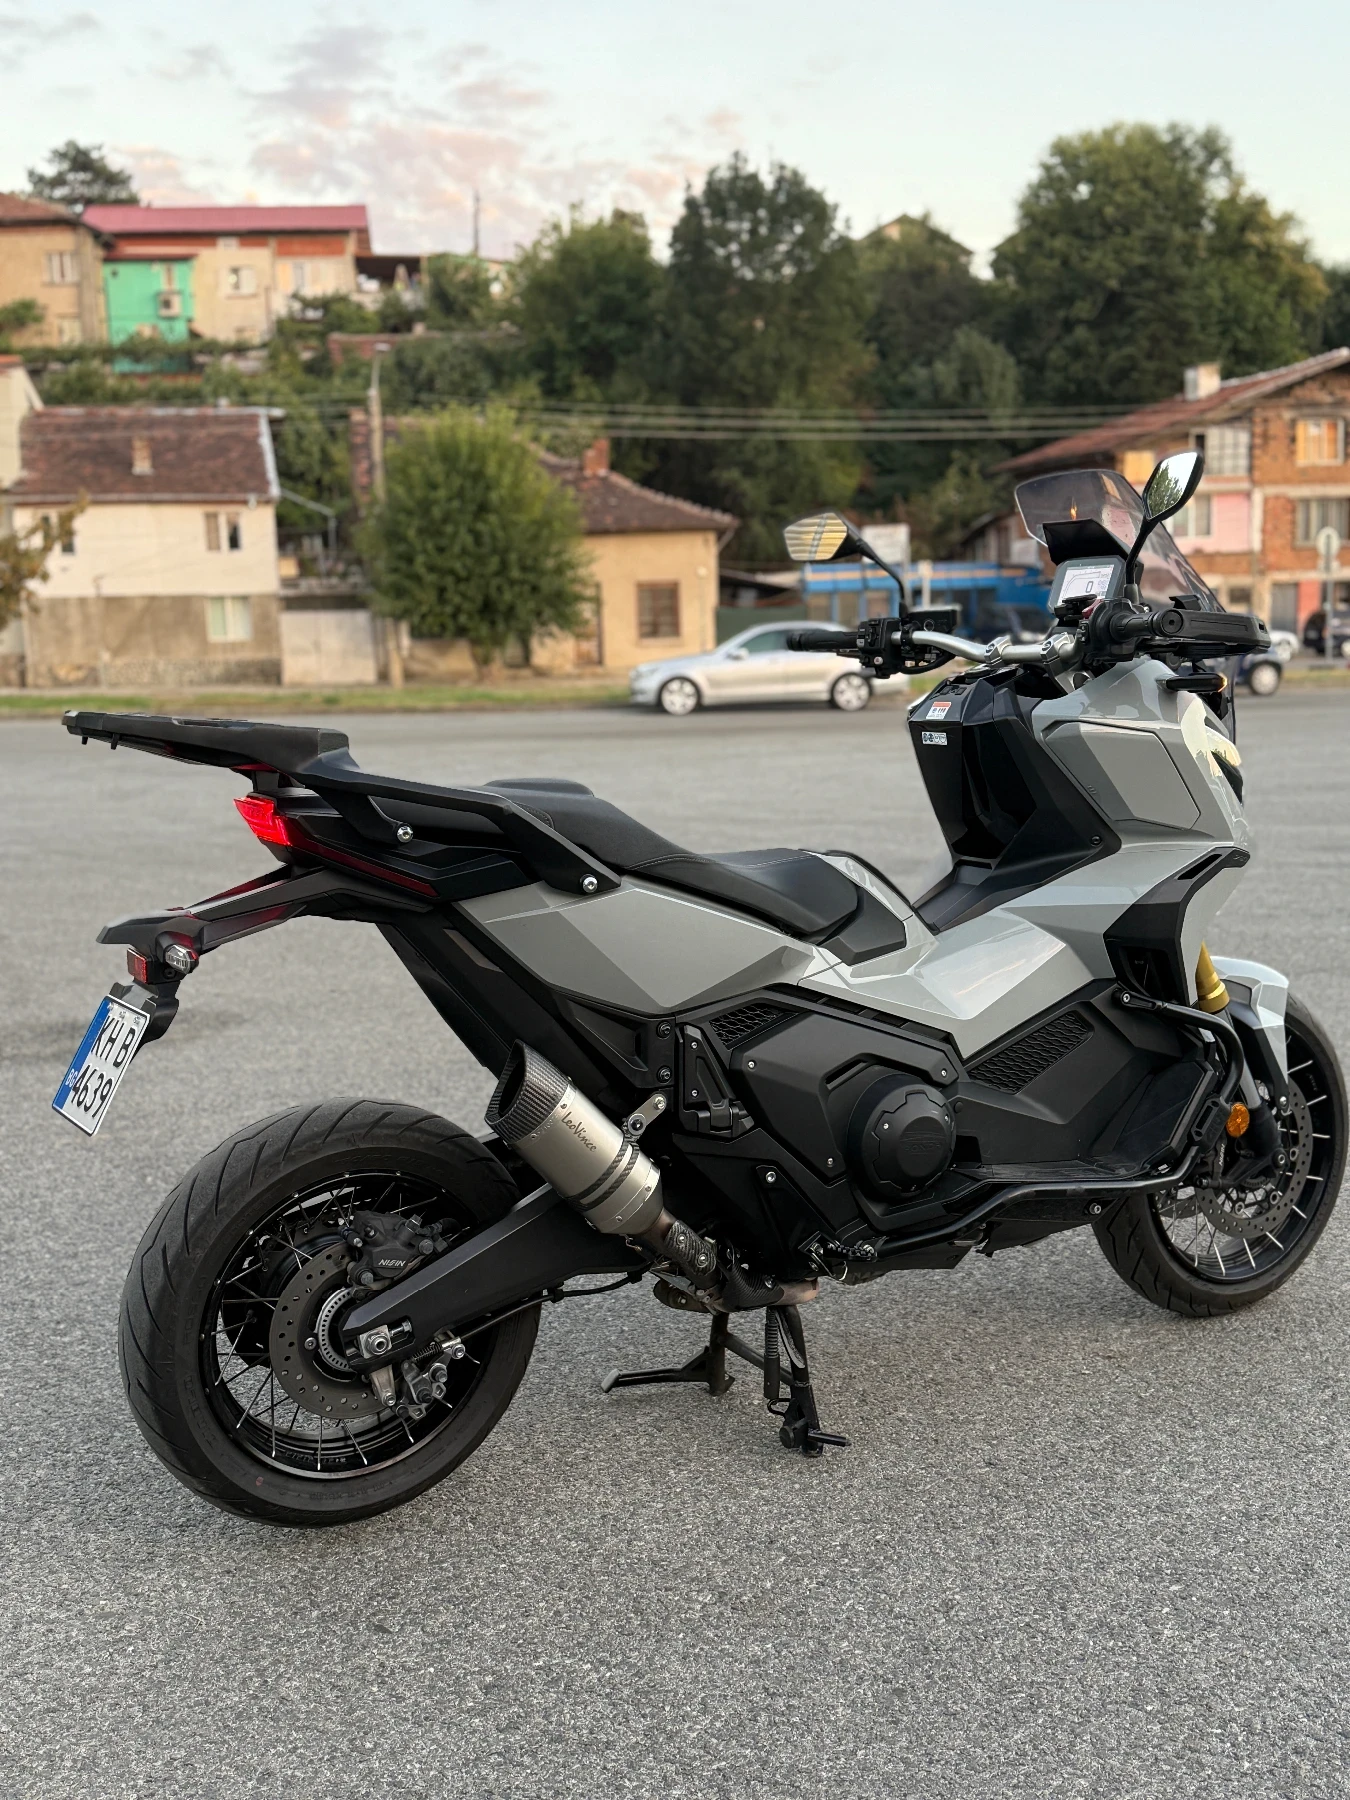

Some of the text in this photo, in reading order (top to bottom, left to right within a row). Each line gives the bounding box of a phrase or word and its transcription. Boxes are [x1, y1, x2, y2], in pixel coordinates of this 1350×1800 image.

[1085, 580, 1094, 593] 0
[90, 1015, 136, 1068] KH B
[65, 1068, 78, 1087] BG
[71, 1064, 113, 1118] 4639
[561, 1111, 597, 1152] LeoVince
